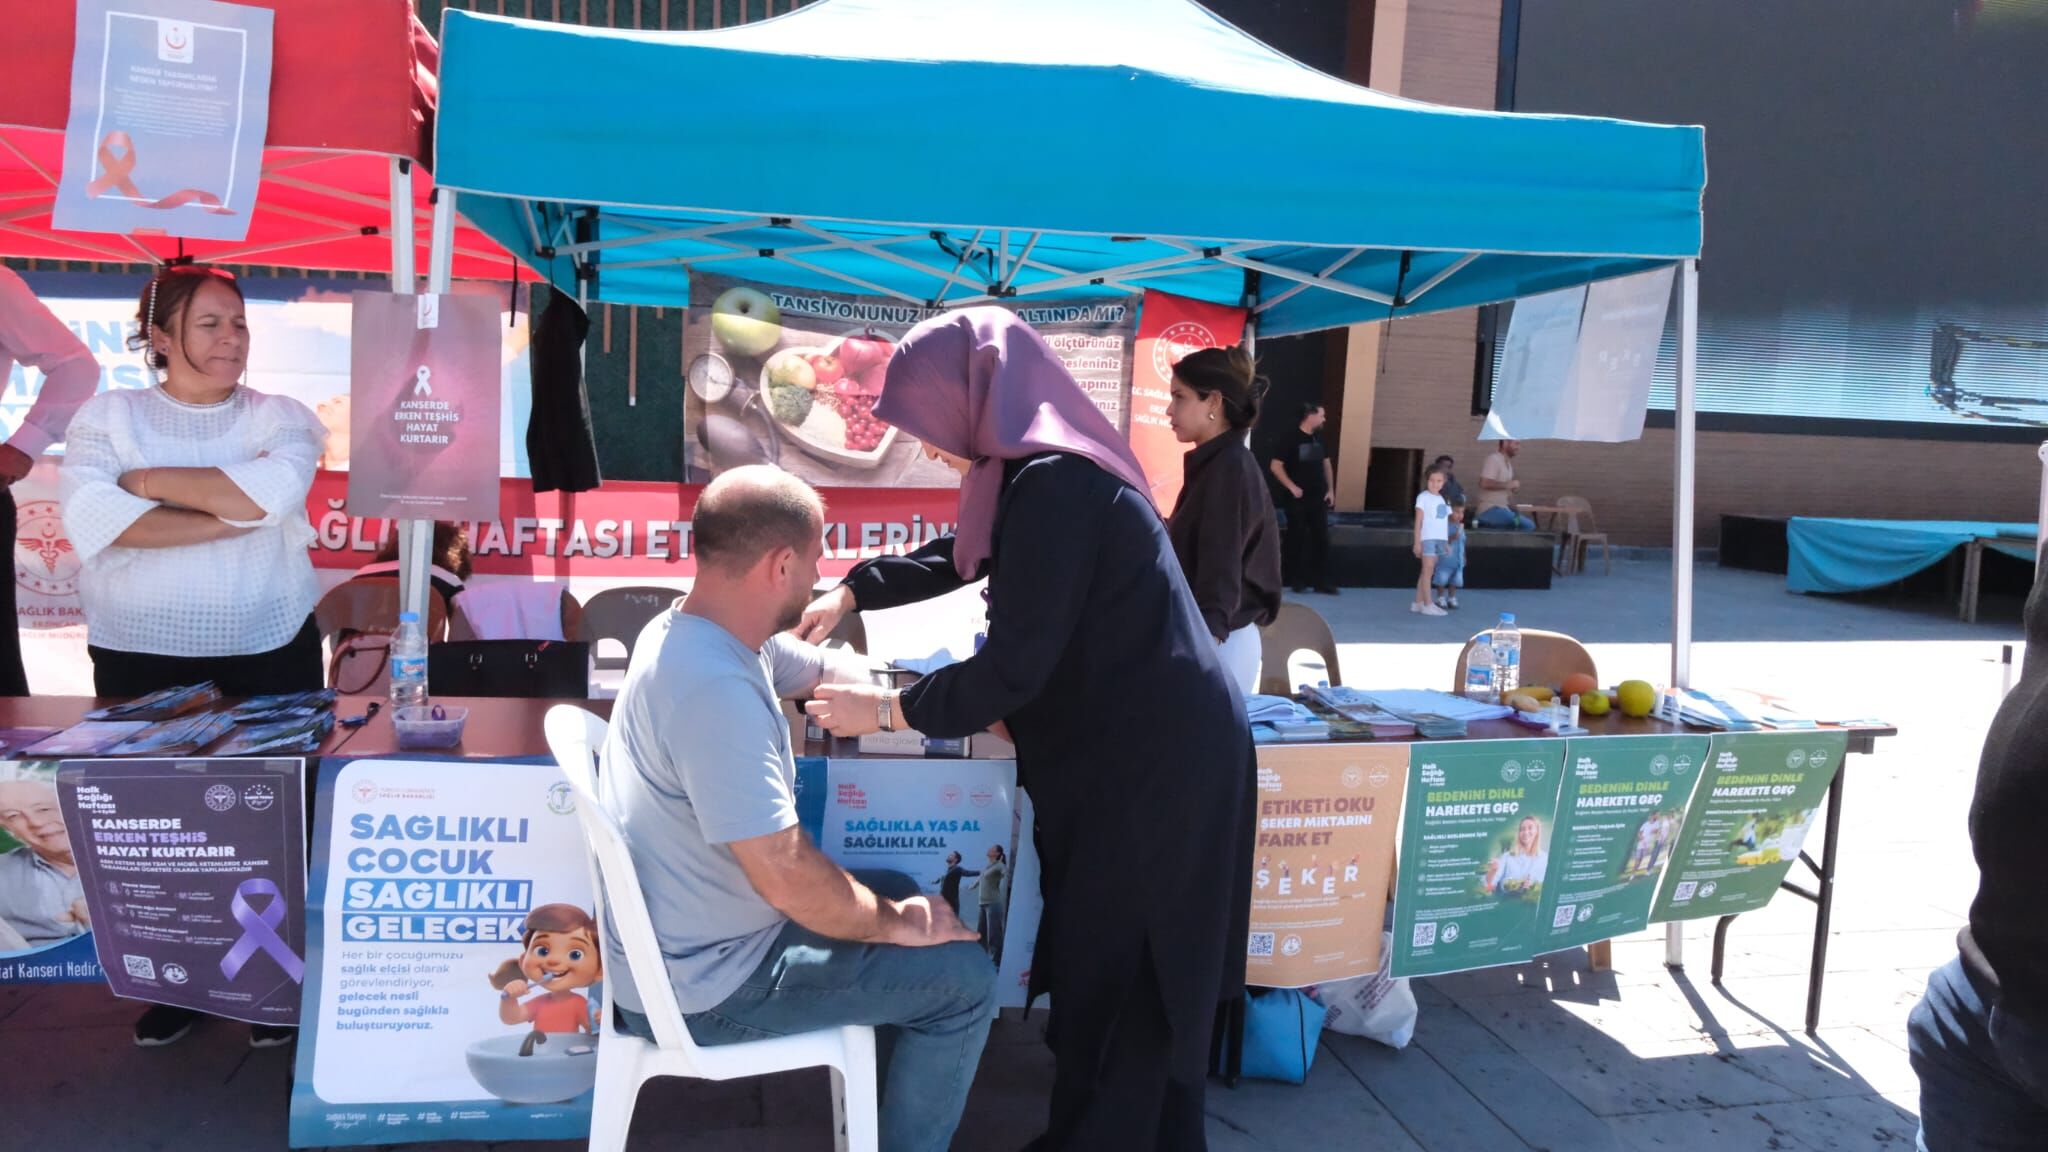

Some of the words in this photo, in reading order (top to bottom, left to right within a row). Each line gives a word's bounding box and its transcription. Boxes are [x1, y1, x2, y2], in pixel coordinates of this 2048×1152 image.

[772, 294, 920, 324] TANSİYONUNUZ
[1016, 306, 1091, 323] ALTINDA
[1054, 336, 1121, 352] ölçtürünüz
[1077, 382, 1118, 391] apınız
[400, 400, 450, 411] KANSERDE
[394, 411, 422, 421] ERKEN
[424, 411, 460, 424] TEŞHİS
[406, 422, 439, 433] HAYAT
[399, 434, 449, 445] KURTARIR
[18, 605, 55, 616] AĞLIK
[1427, 789, 1486, 802] BEDENİNİ
[1488, 787, 1525, 800] DİNLE
[1712, 785, 1771, 797] HAREKETE
[1772, 785, 1797, 797] GEÇ
[1334, 797, 1375, 813] OKU
[1576, 795, 1638, 808] HAREKETE
[1638, 794, 1663, 807] GEÇ
[1425, 804, 1491, 817] HAREKETE
[1492, 802, 1520, 815] GEÇ
[92, 818, 182, 830] KANSERDE
[844, 817, 924, 832] SAĞLIKLA
[927, 819, 959, 834] YAŞ
[961, 819, 981, 832] AL
[1261, 817, 1302, 831] ŞEKER
[1304, 814, 1373, 828] MİKTARINI
[94, 831, 147, 843] ERKEN
[149, 831, 208, 845] TEŞHİS
[843, 834, 915, 849] SAĞLIKLI
[917, 837, 947, 849] KAL
[1259, 832, 1308, 847] FARK
[1311, 831, 1333, 846] ET
[96, 845, 149, 857] HAYAT
[152, 845, 236, 858] KURTARIR
[345, 915, 526, 942] GELECEK
[342, 951, 364, 960] Her
[366, 951, 383, 960] bir
[386, 951, 464, 962] çocuğumuzu
[18, 963, 63, 979] Kanseri
[67, 961, 97, 977] Nedir
[340, 964, 376, 975] sağlık
[379, 964, 411, 975] elçisi
[413, 964, 450, 974] olarak
[338, 991, 388, 1003] gelecek
[390, 990, 420, 1001] nesli
[337, 1006, 401, 1017] bugünden
[402, 1006, 450, 1017] sağlıkla
